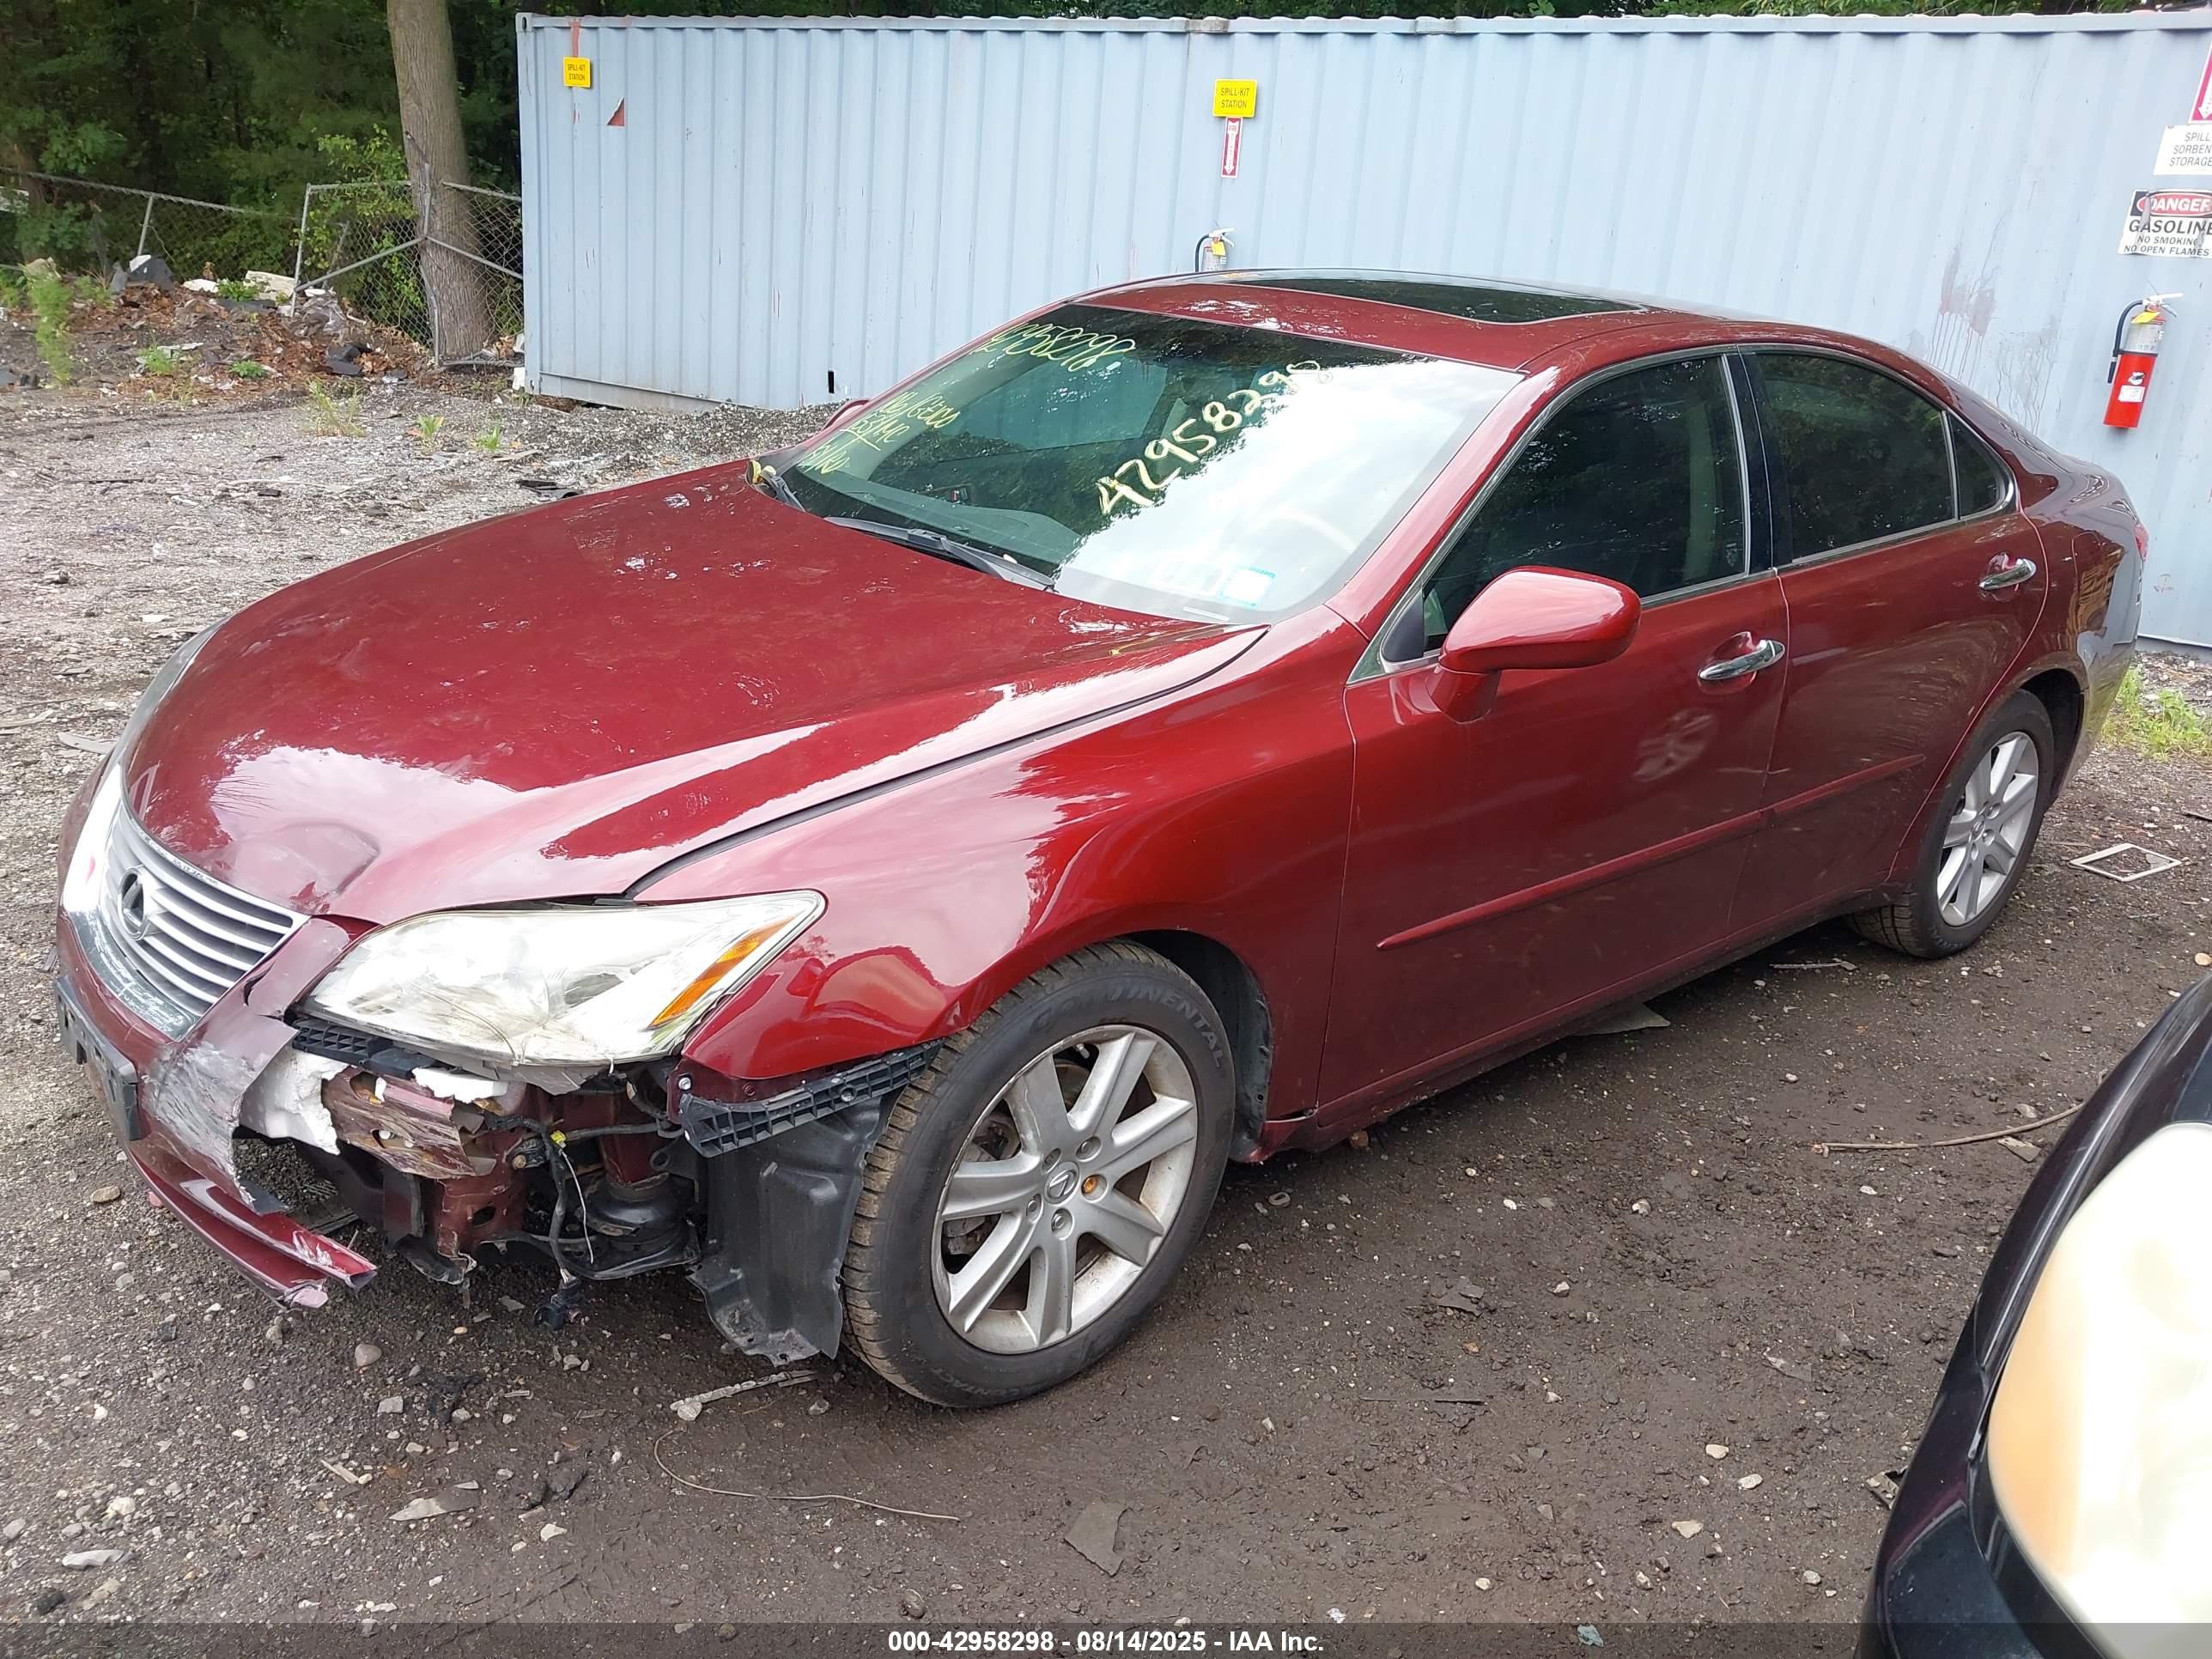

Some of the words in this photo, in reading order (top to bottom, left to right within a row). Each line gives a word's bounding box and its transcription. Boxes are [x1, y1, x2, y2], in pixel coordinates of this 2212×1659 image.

[1221, 88, 1250, 96] SPILL-KIT
[1221, 100, 1248, 108] STATION
[2185, 132, 2211, 142] SPILL
[2172, 144, 2212, 155] SORBEN
[2169, 156, 2212, 167] STORAGE
[2129, 219, 2212, 235] GASOLINE
[2137, 235, 2151, 244] NO
[2124, 245, 2137, 253] NO
[2140, 245, 2166, 254] OPEN
[2169, 246, 2209, 257] FLAMES
[1032, 984, 1225, 1069] COTINENTAL
